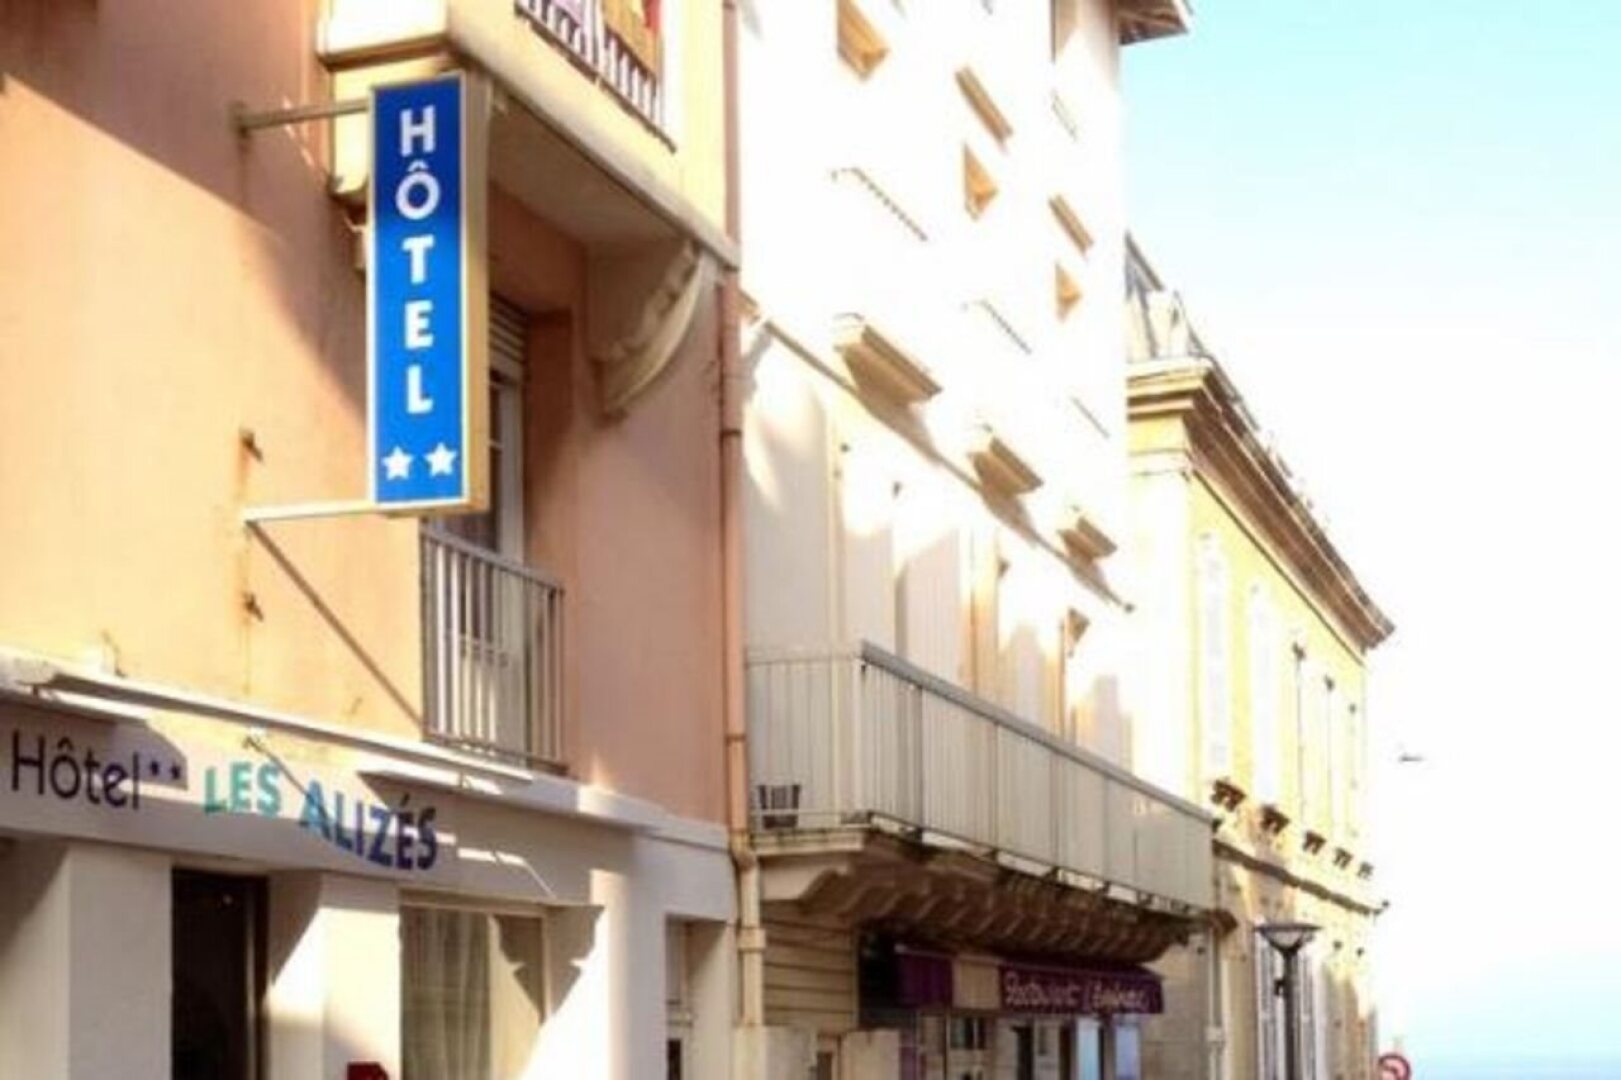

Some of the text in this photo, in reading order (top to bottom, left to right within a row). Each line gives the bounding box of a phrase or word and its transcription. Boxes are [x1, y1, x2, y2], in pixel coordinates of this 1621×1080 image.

[395, 105, 441, 414] HÔTEL
[11, 729, 438, 871] Hôtel LES ALIZÉS
